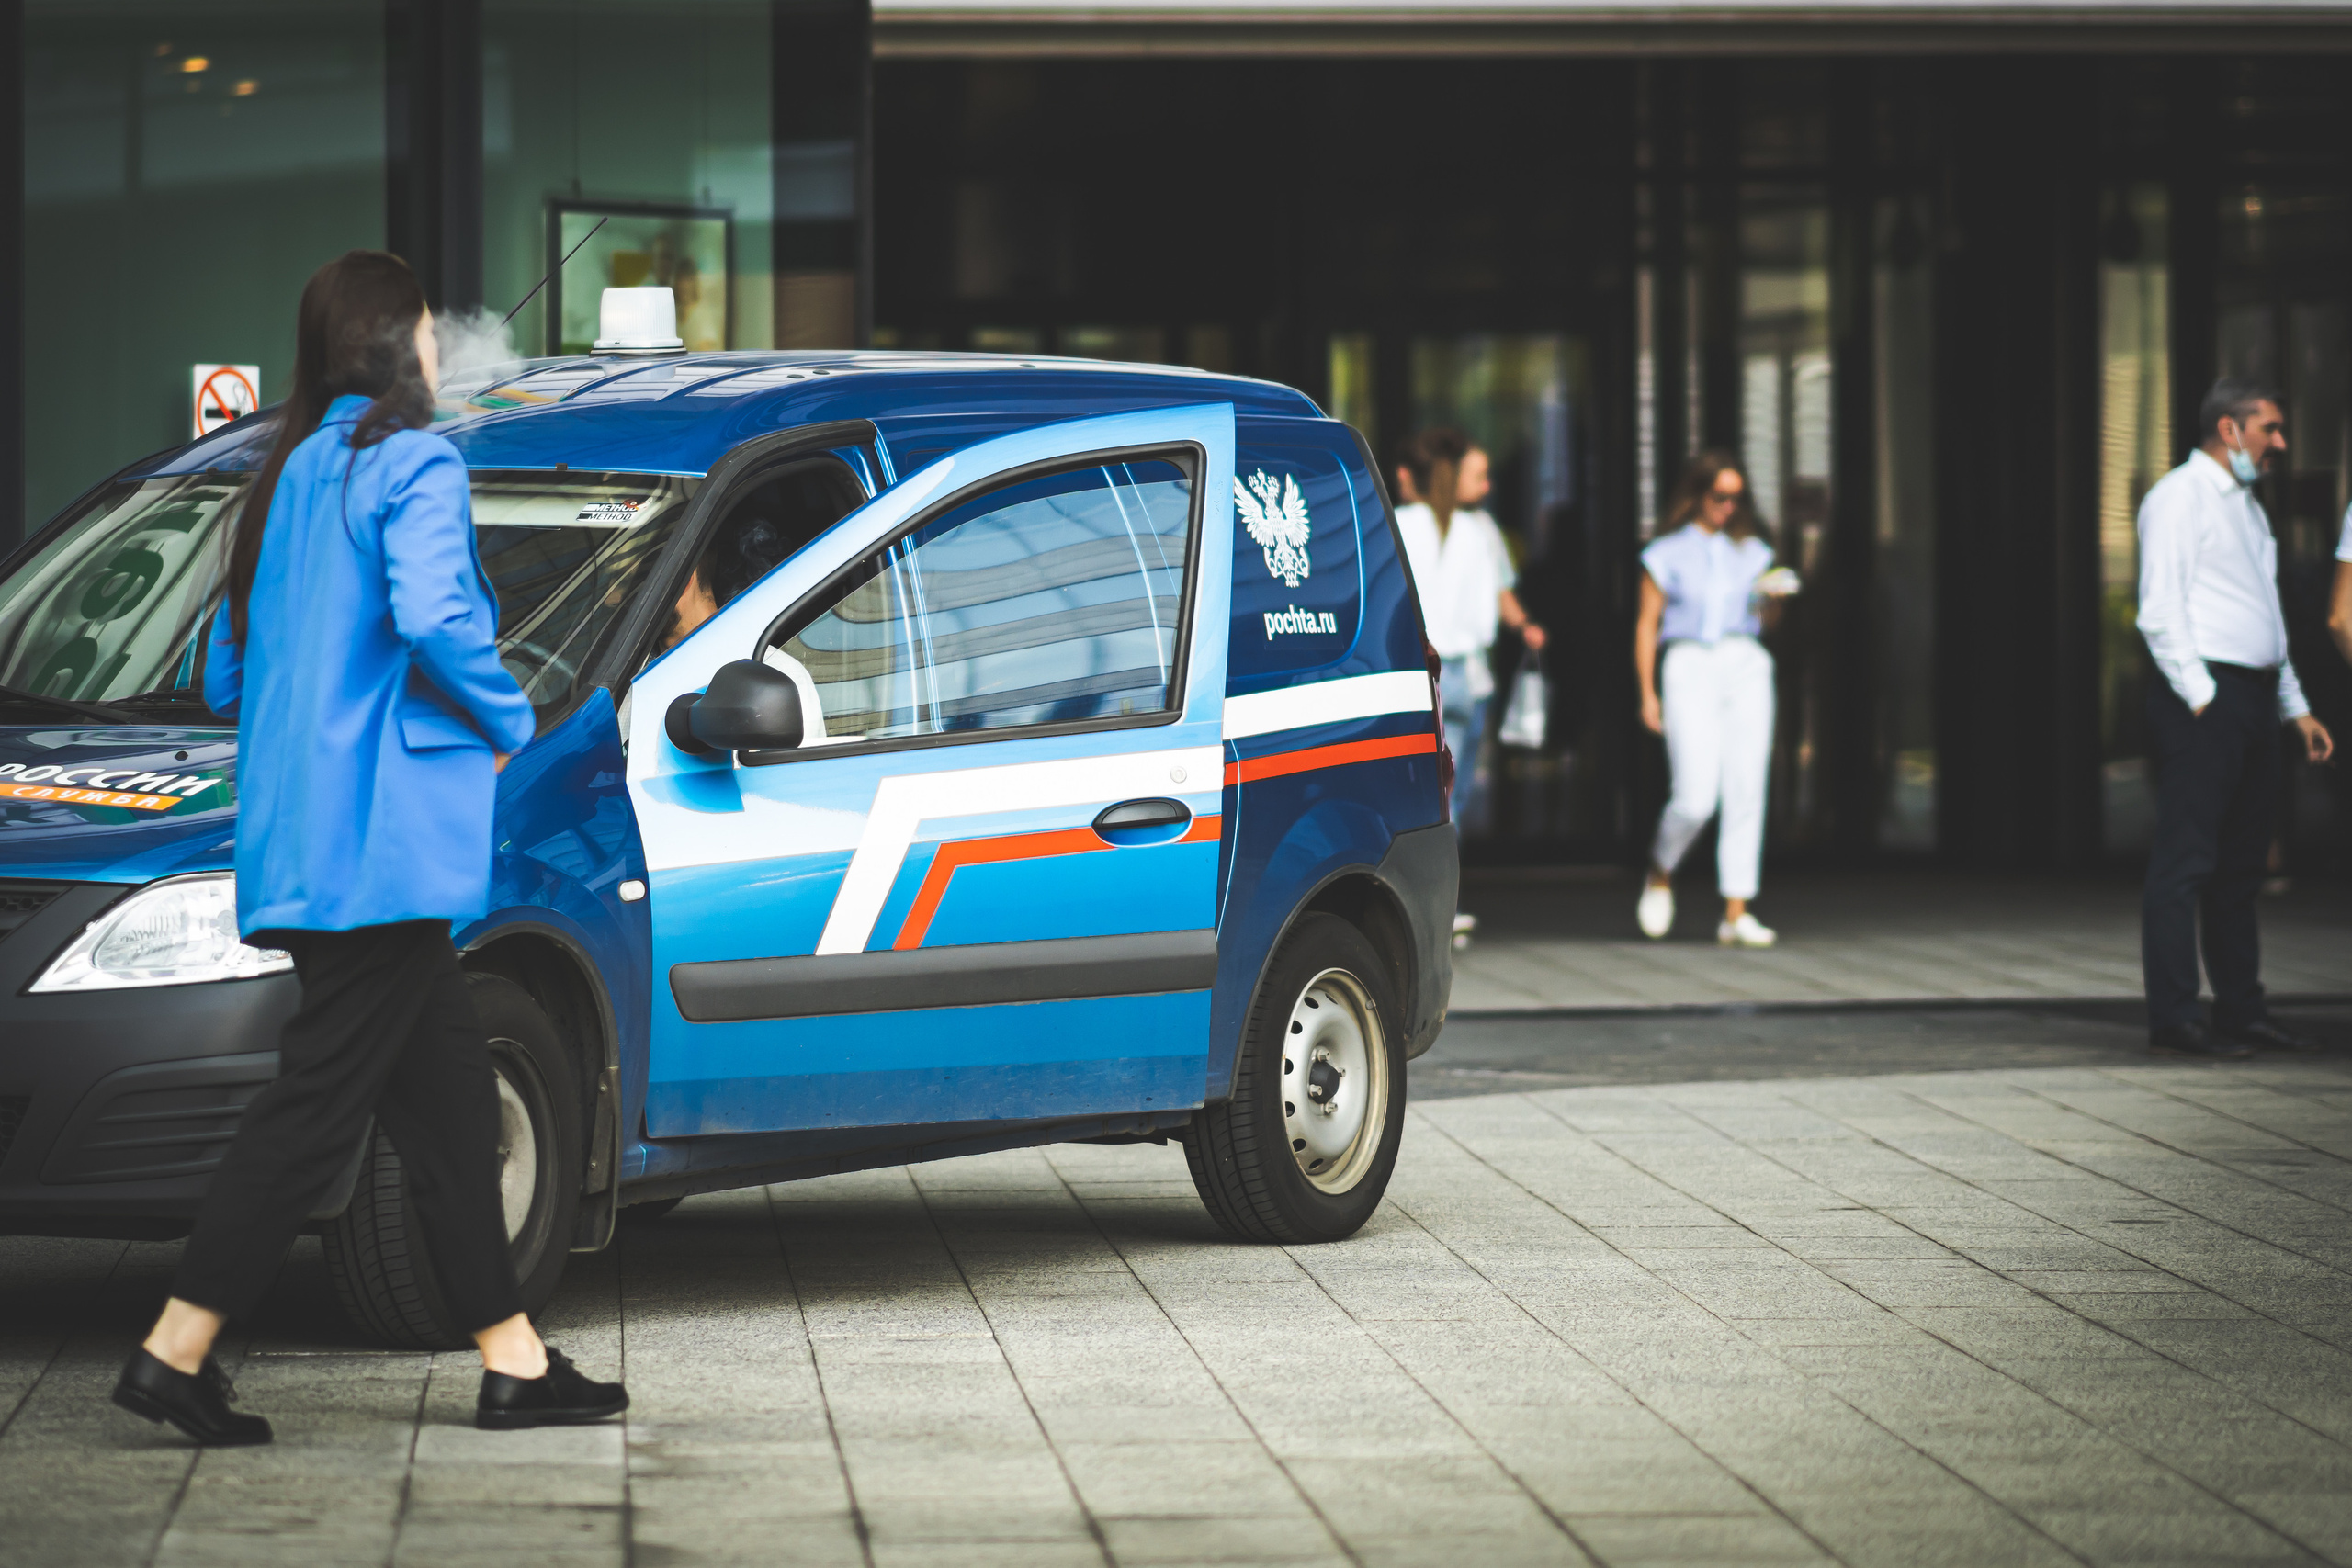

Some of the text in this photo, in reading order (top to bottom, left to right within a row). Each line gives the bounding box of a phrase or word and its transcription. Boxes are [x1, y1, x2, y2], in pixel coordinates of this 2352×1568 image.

[588, 513, 632, 521] METHOD
[1263, 604, 1337, 641] pochta.ru
[12, 786, 161, 807] СЛУЖБА
